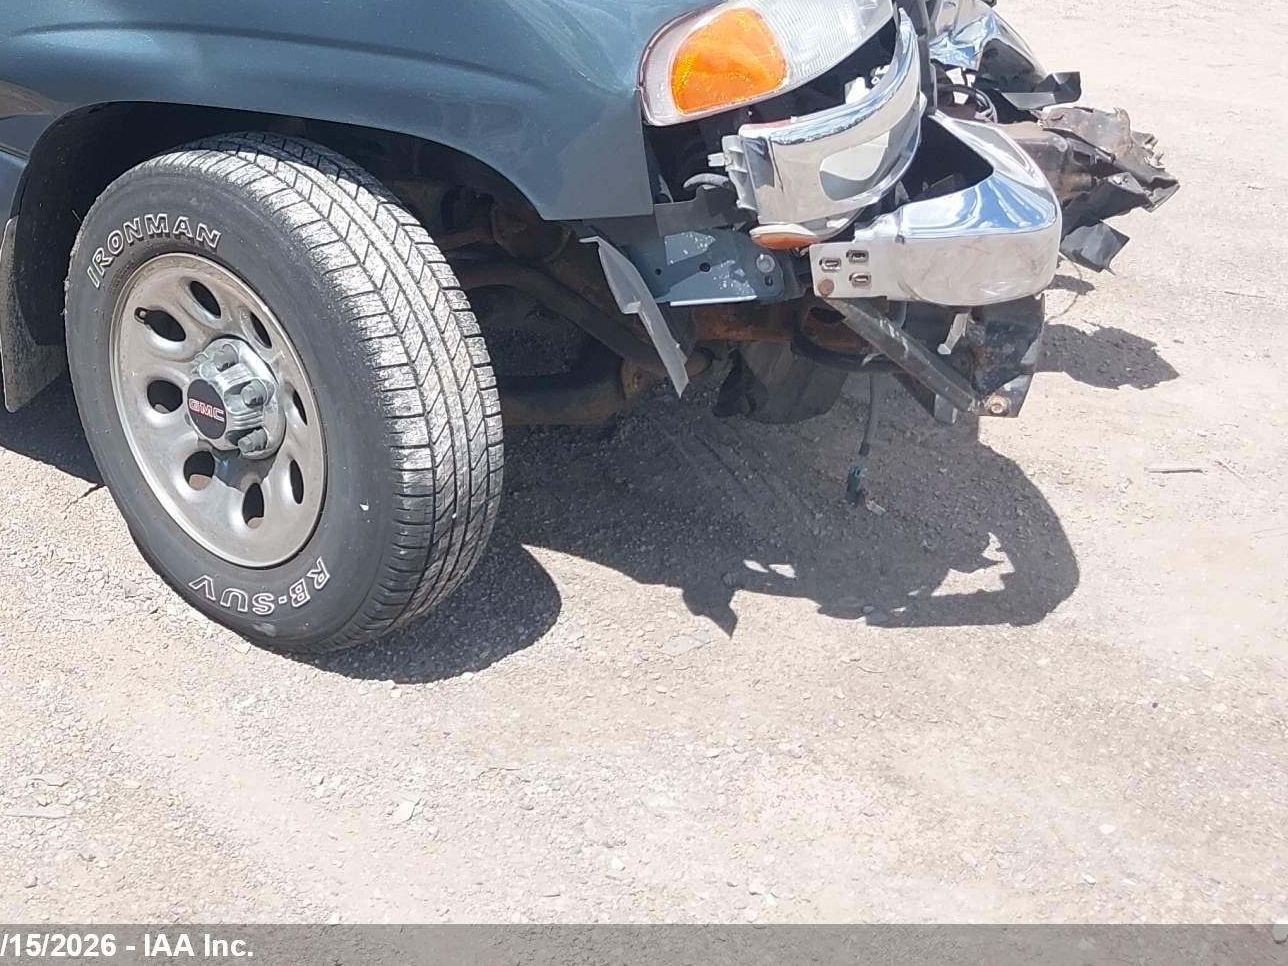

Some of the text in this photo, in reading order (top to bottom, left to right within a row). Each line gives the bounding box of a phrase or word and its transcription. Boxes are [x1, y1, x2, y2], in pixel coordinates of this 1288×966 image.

[87, 213, 221, 288] IRONMAN
[188, 398, 225, 422] GMC
[188, 556, 330, 615] RB-SUV
